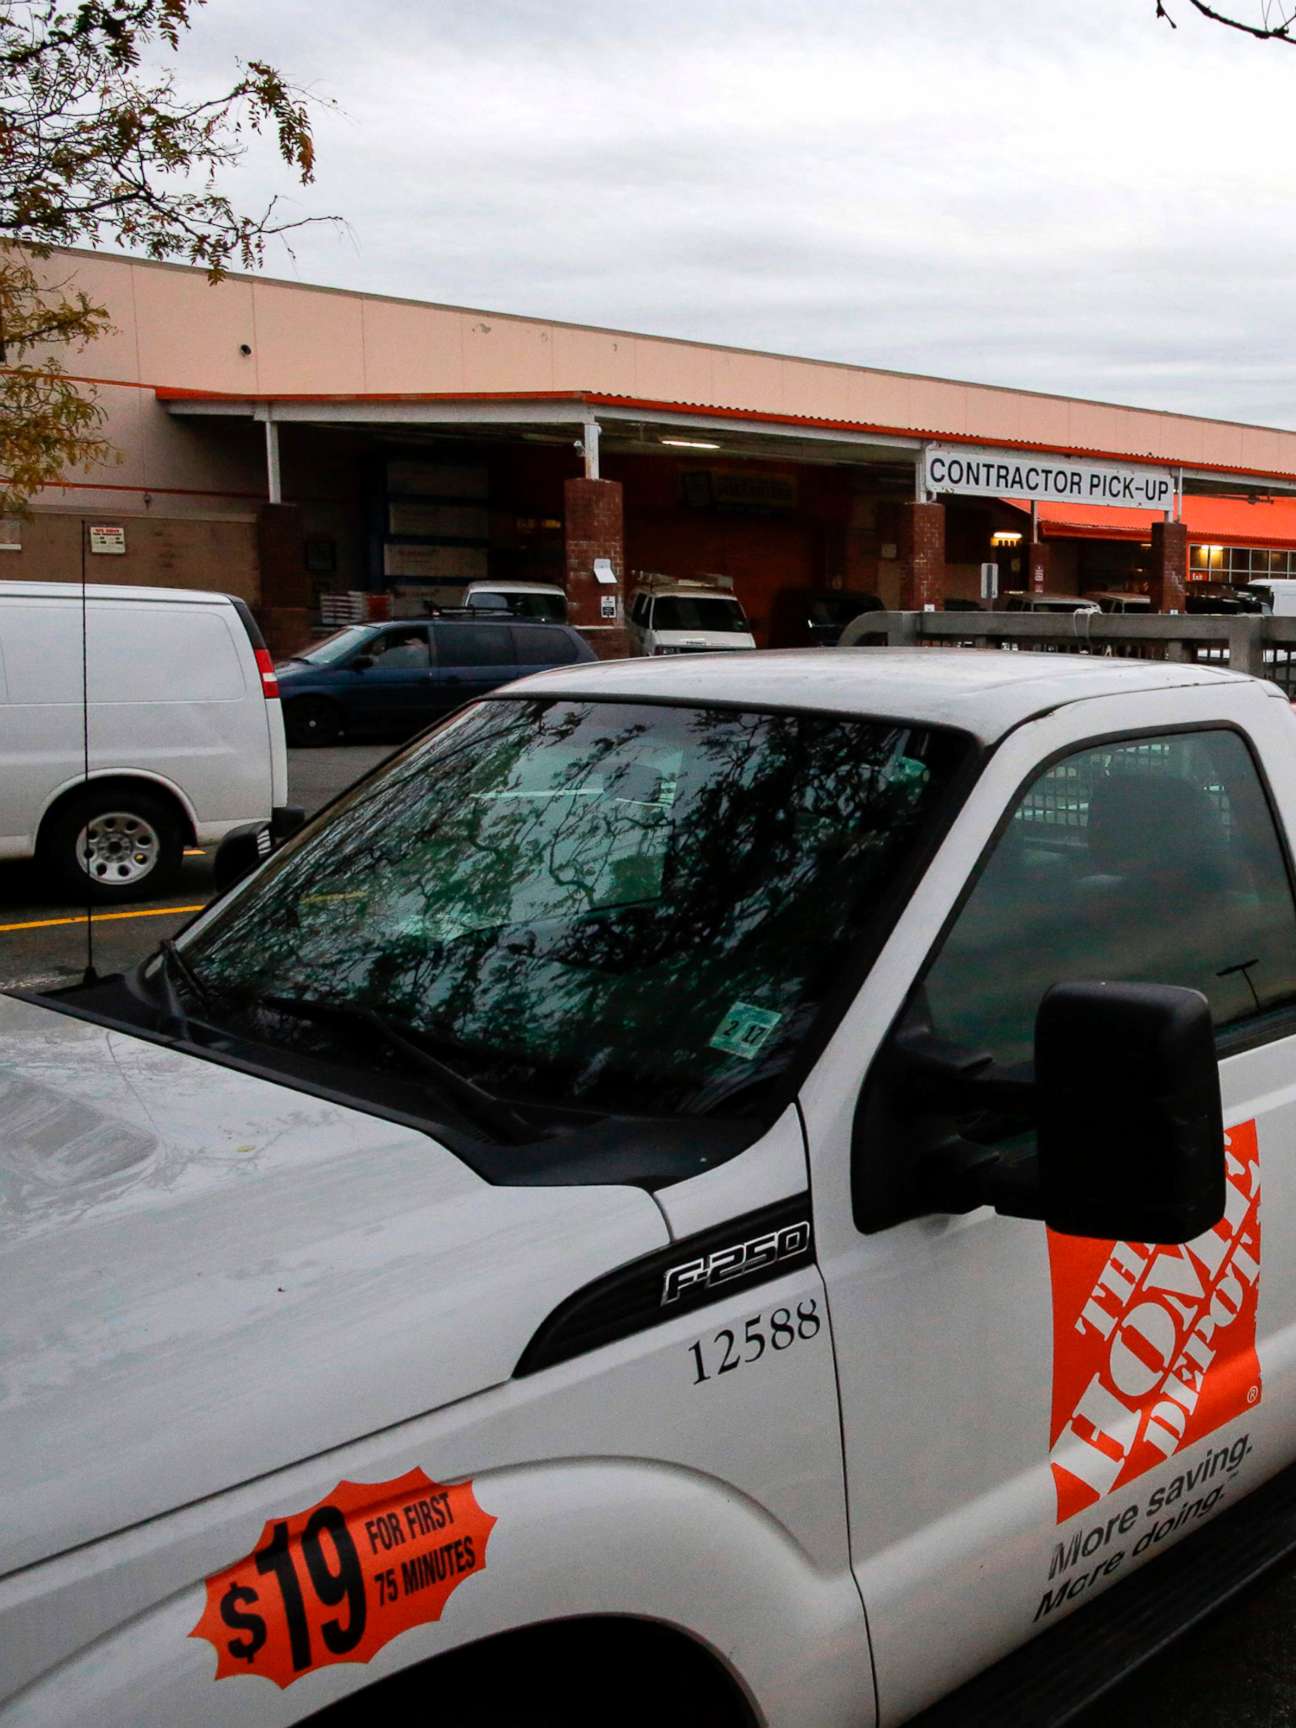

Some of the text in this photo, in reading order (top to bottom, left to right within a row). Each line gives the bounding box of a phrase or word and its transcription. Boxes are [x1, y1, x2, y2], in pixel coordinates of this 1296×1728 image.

[930, 457, 1170, 502] CONTRACTOR PICK-UP
[741, 1024, 768, 1045] 17
[661, 1221, 811, 1306] F-250
[688, 1299, 820, 1385] 12588
[365, 1491, 455, 1555] FOR FIRST
[1048, 1434, 1254, 1582] More saving.
[219, 1505, 367, 1672] $19
[373, 1535, 477, 1607] 75 MINUTES
[1033, 1485, 1225, 1623] More doing.
